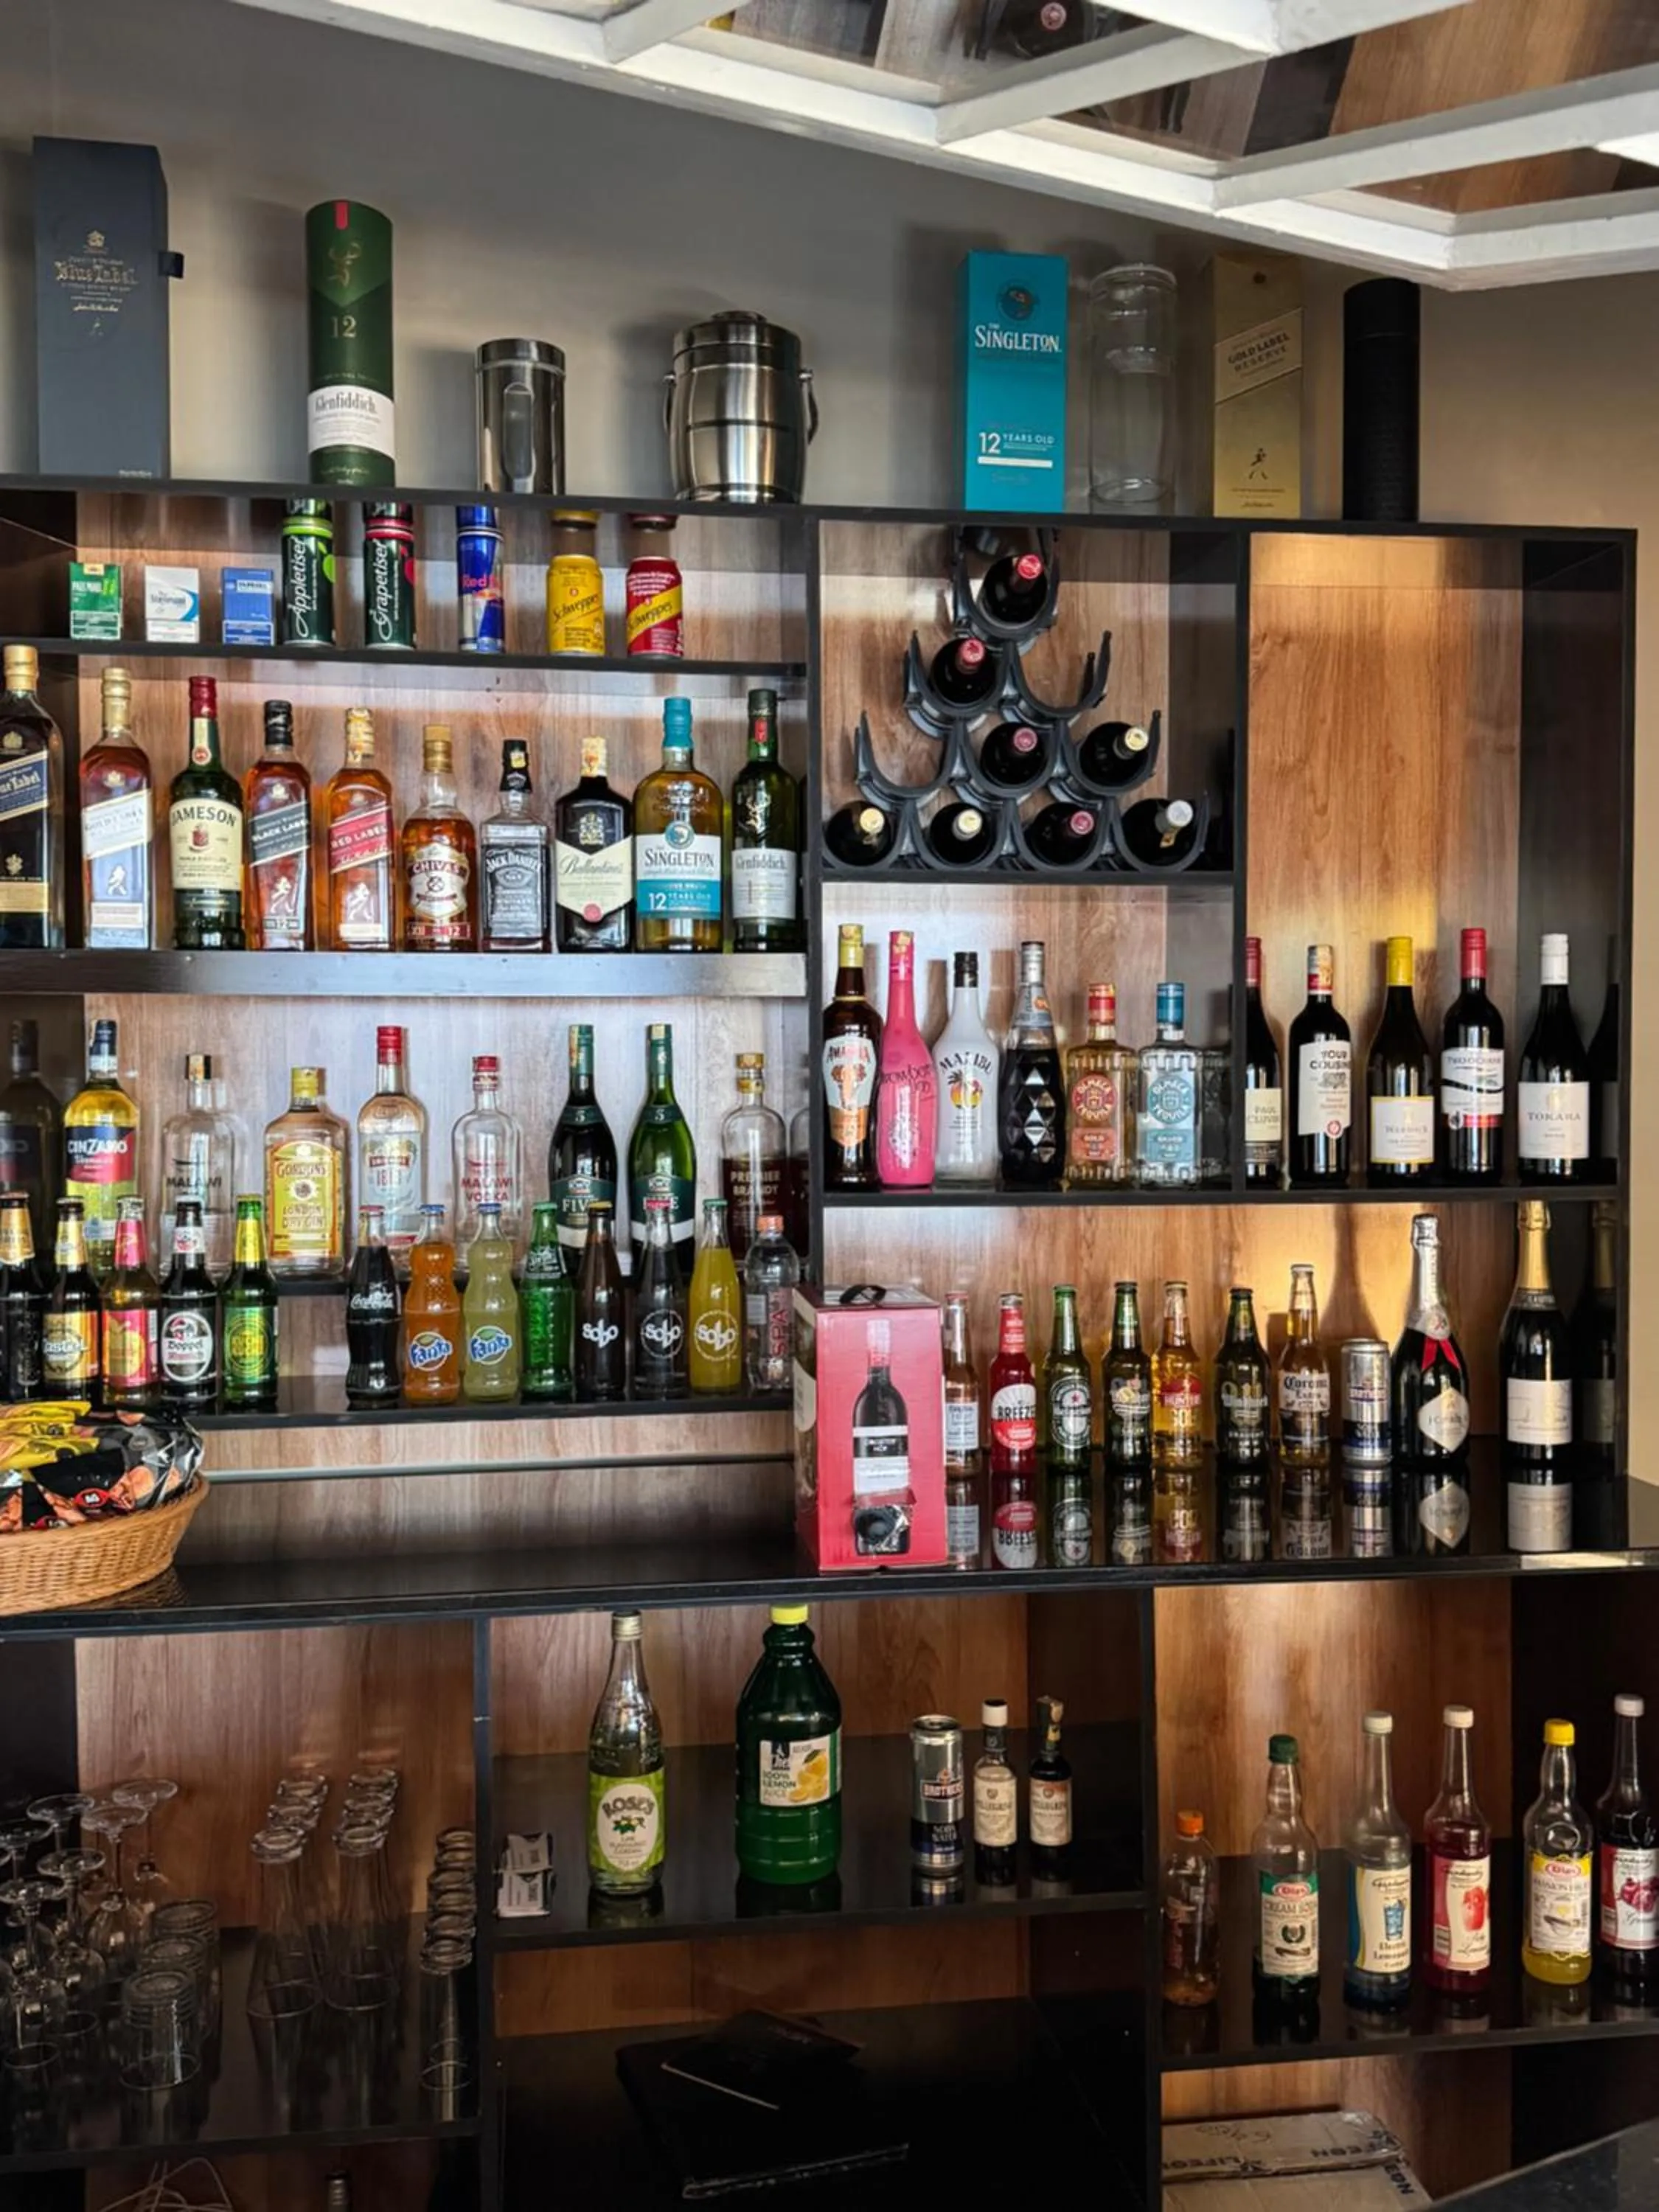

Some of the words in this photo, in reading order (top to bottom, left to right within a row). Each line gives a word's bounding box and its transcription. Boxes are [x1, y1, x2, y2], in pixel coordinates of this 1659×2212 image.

[330, 315, 358, 340] 12
[974, 325, 1062, 352] SINGLETON
[978, 431, 1001, 454] 12
[1002, 433, 1032, 443] YEARS
[1034, 435, 1055, 445] OLD
[288, 535, 309, 639] Appletiser
[369, 538, 392, 641] Grapetiser
[172, 805, 236, 827] JAMESON
[331, 835, 352, 849] RED
[354, 824, 388, 841] LABEL
[412, 860, 460, 874] CHIVAS
[644, 849, 714, 869] SINGLETON
[649, 894, 667, 911] 12
[574, 1110, 585, 1122] 5
[654, 1108, 664, 1121] 5
[410, 1339, 452, 1366] Fanta
[470, 1333, 511, 1362] Fanta
